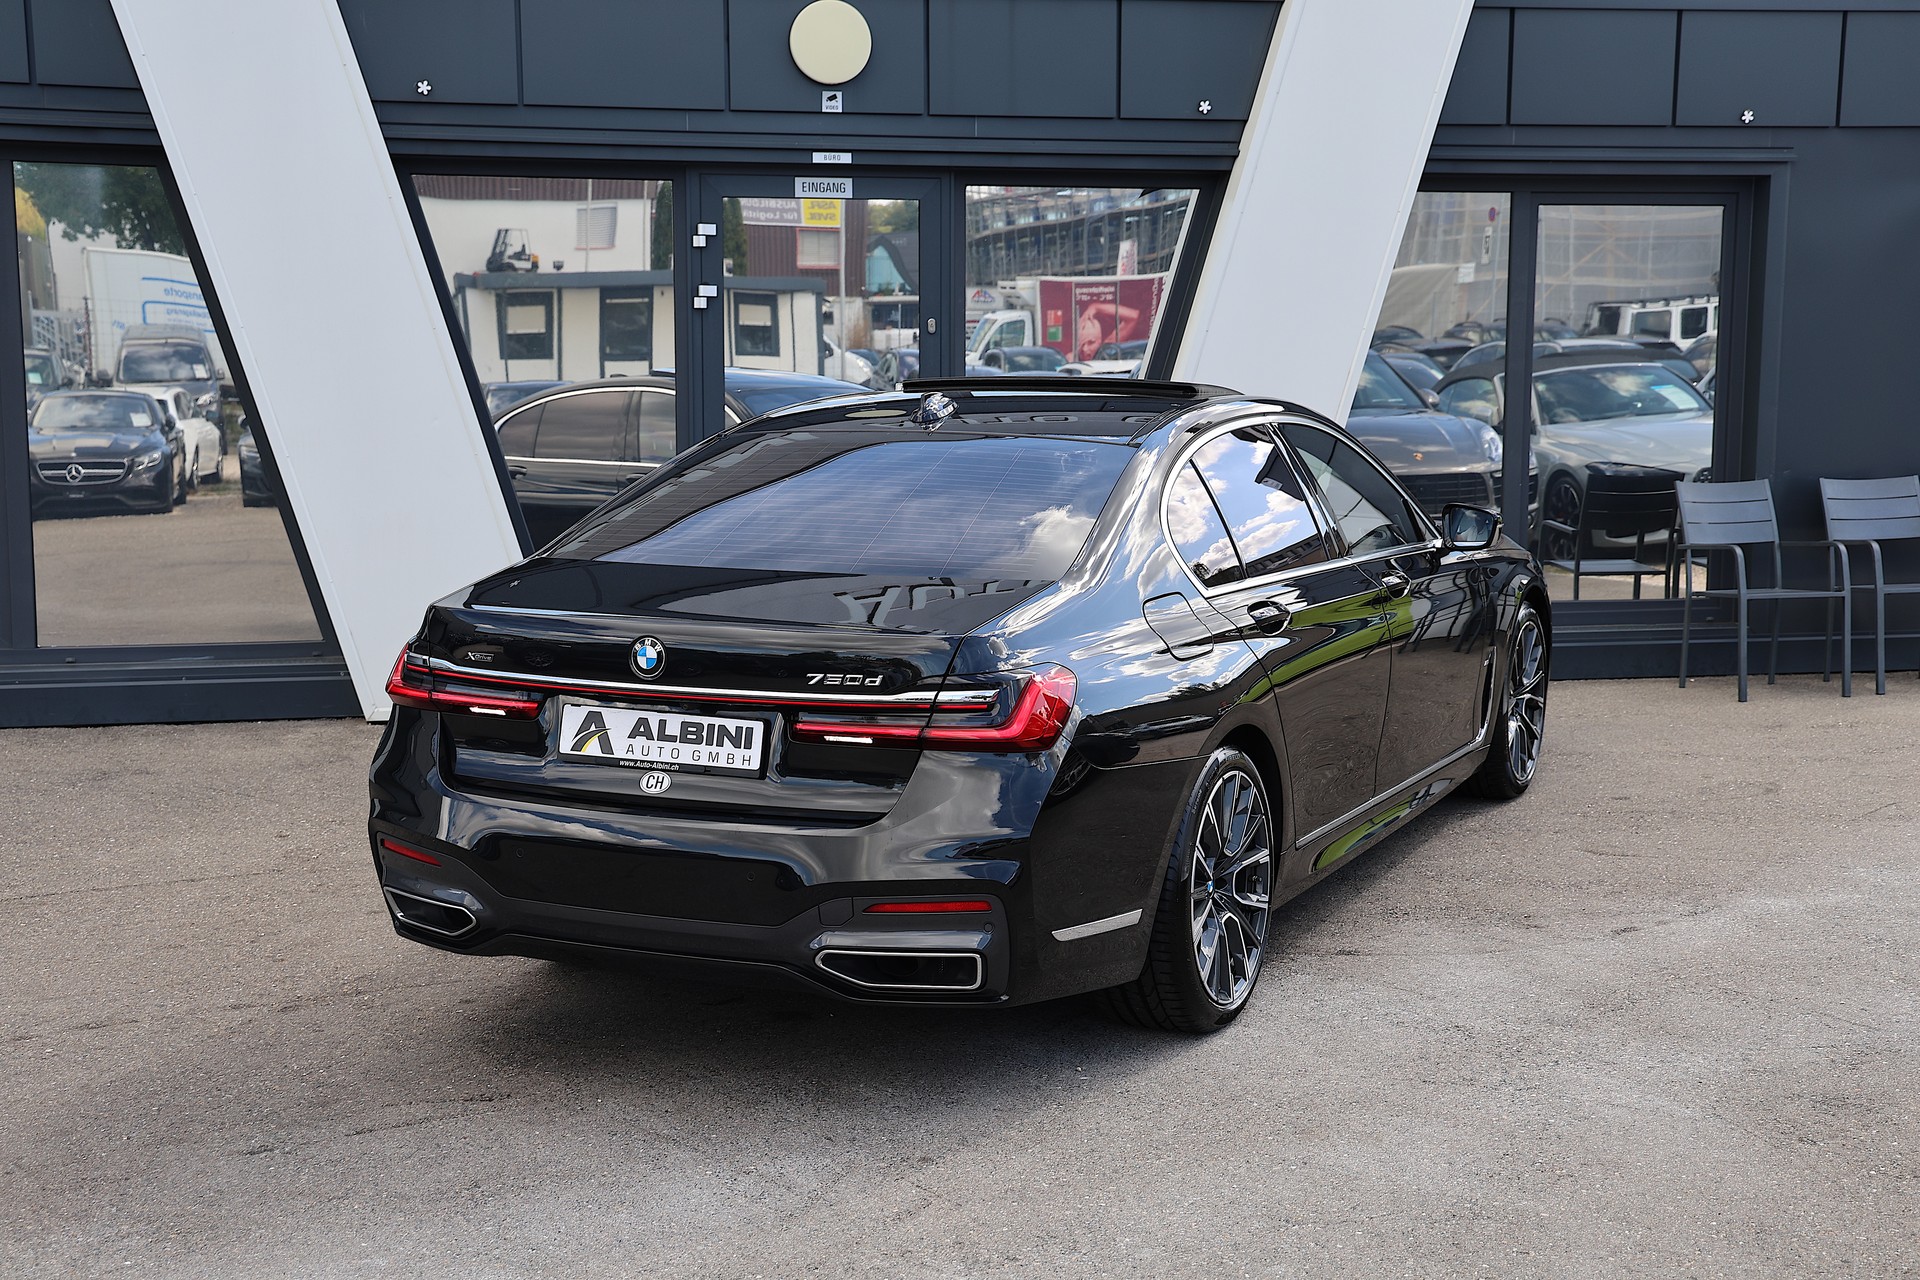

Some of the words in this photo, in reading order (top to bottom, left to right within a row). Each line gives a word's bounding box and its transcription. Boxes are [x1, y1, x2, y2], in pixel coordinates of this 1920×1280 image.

[823, 153, 841, 161] BÜRO
[801, 181, 846, 193] EINGANG
[634, 638, 662, 652] BMW
[806, 673, 883, 686] 750d
[627, 717, 754, 750] ALBINI
[625, 743, 680, 760] AUTO
[691, 749, 752, 767] GMBH
[619, 759, 680, 772] www.Auto-Albini.ch
[645, 775, 665, 790] CH
